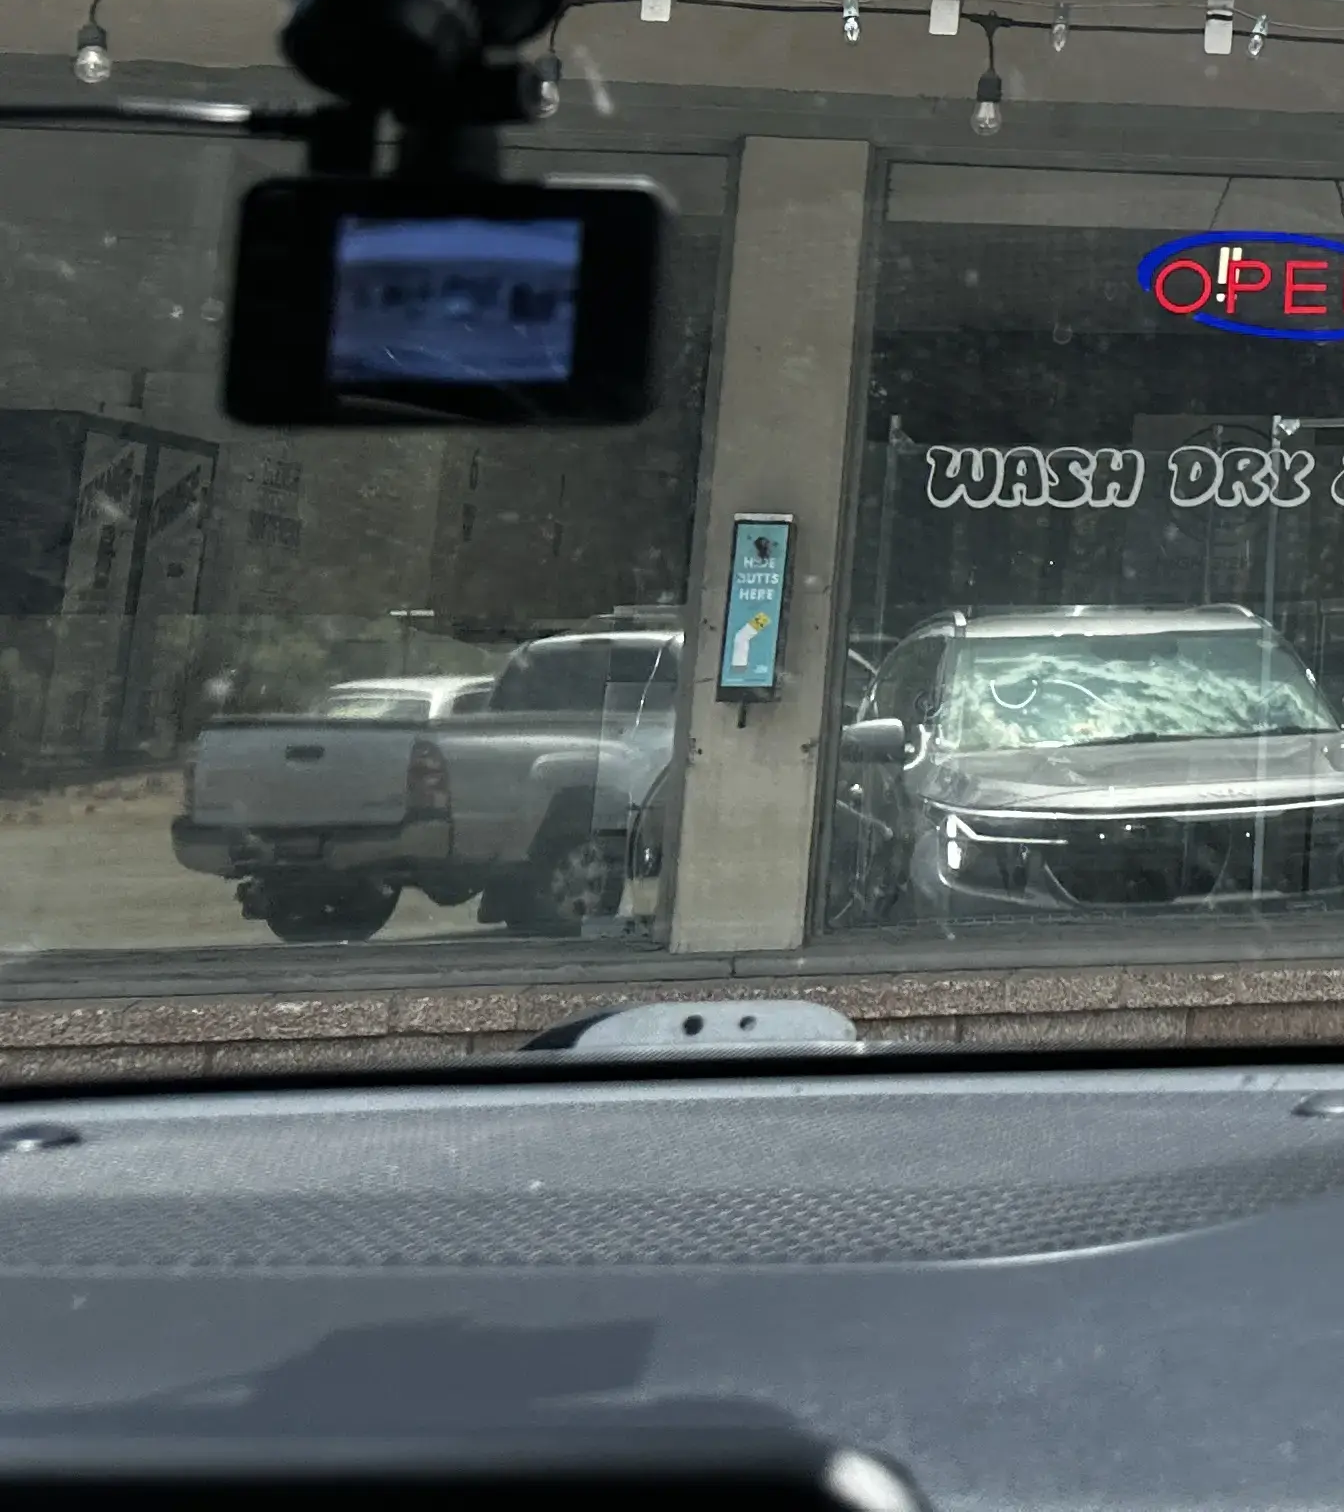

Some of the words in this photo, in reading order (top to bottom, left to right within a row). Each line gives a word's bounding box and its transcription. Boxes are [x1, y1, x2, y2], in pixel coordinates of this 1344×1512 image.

[926, 445, 1144, 509] WASH
[1167, 445, 1316, 508] DRY
[739, 588, 774, 601] HERE
